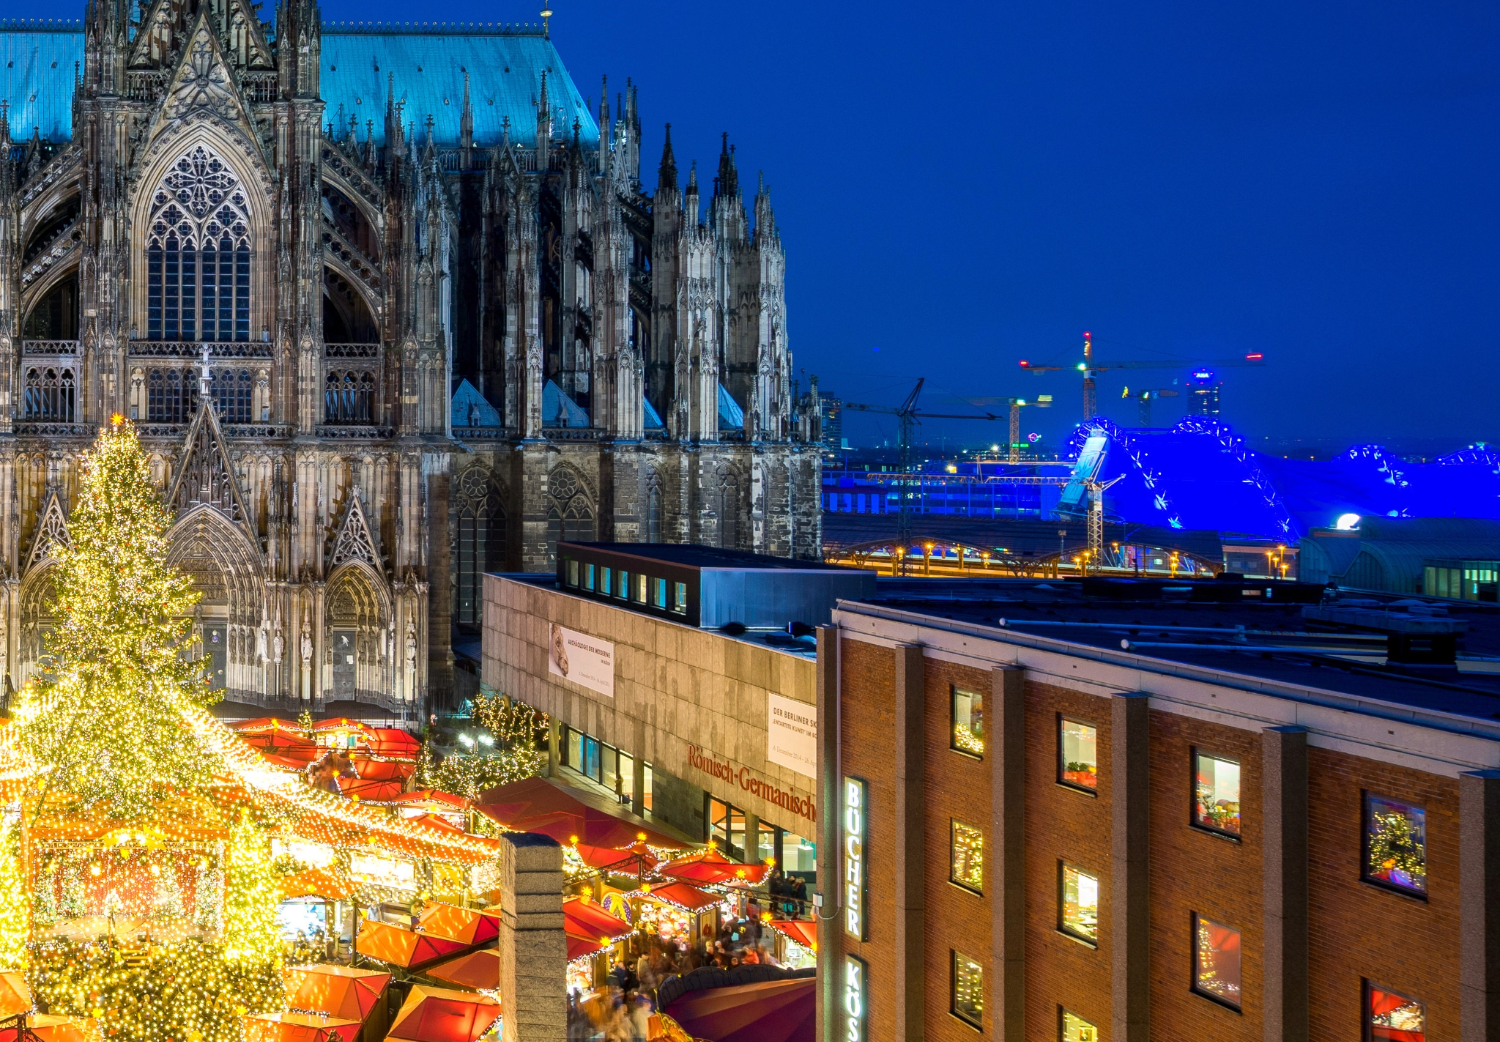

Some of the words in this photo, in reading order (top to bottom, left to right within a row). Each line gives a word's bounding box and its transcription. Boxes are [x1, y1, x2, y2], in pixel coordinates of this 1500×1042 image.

[773, 707, 783, 717] DER
[784, 710, 809, 726] BERLINER
[687, 743, 817, 823] Römisch-Germanisch
[846, 782, 861, 937] BÜCHER
[846, 961, 861, 1042] KÖS
